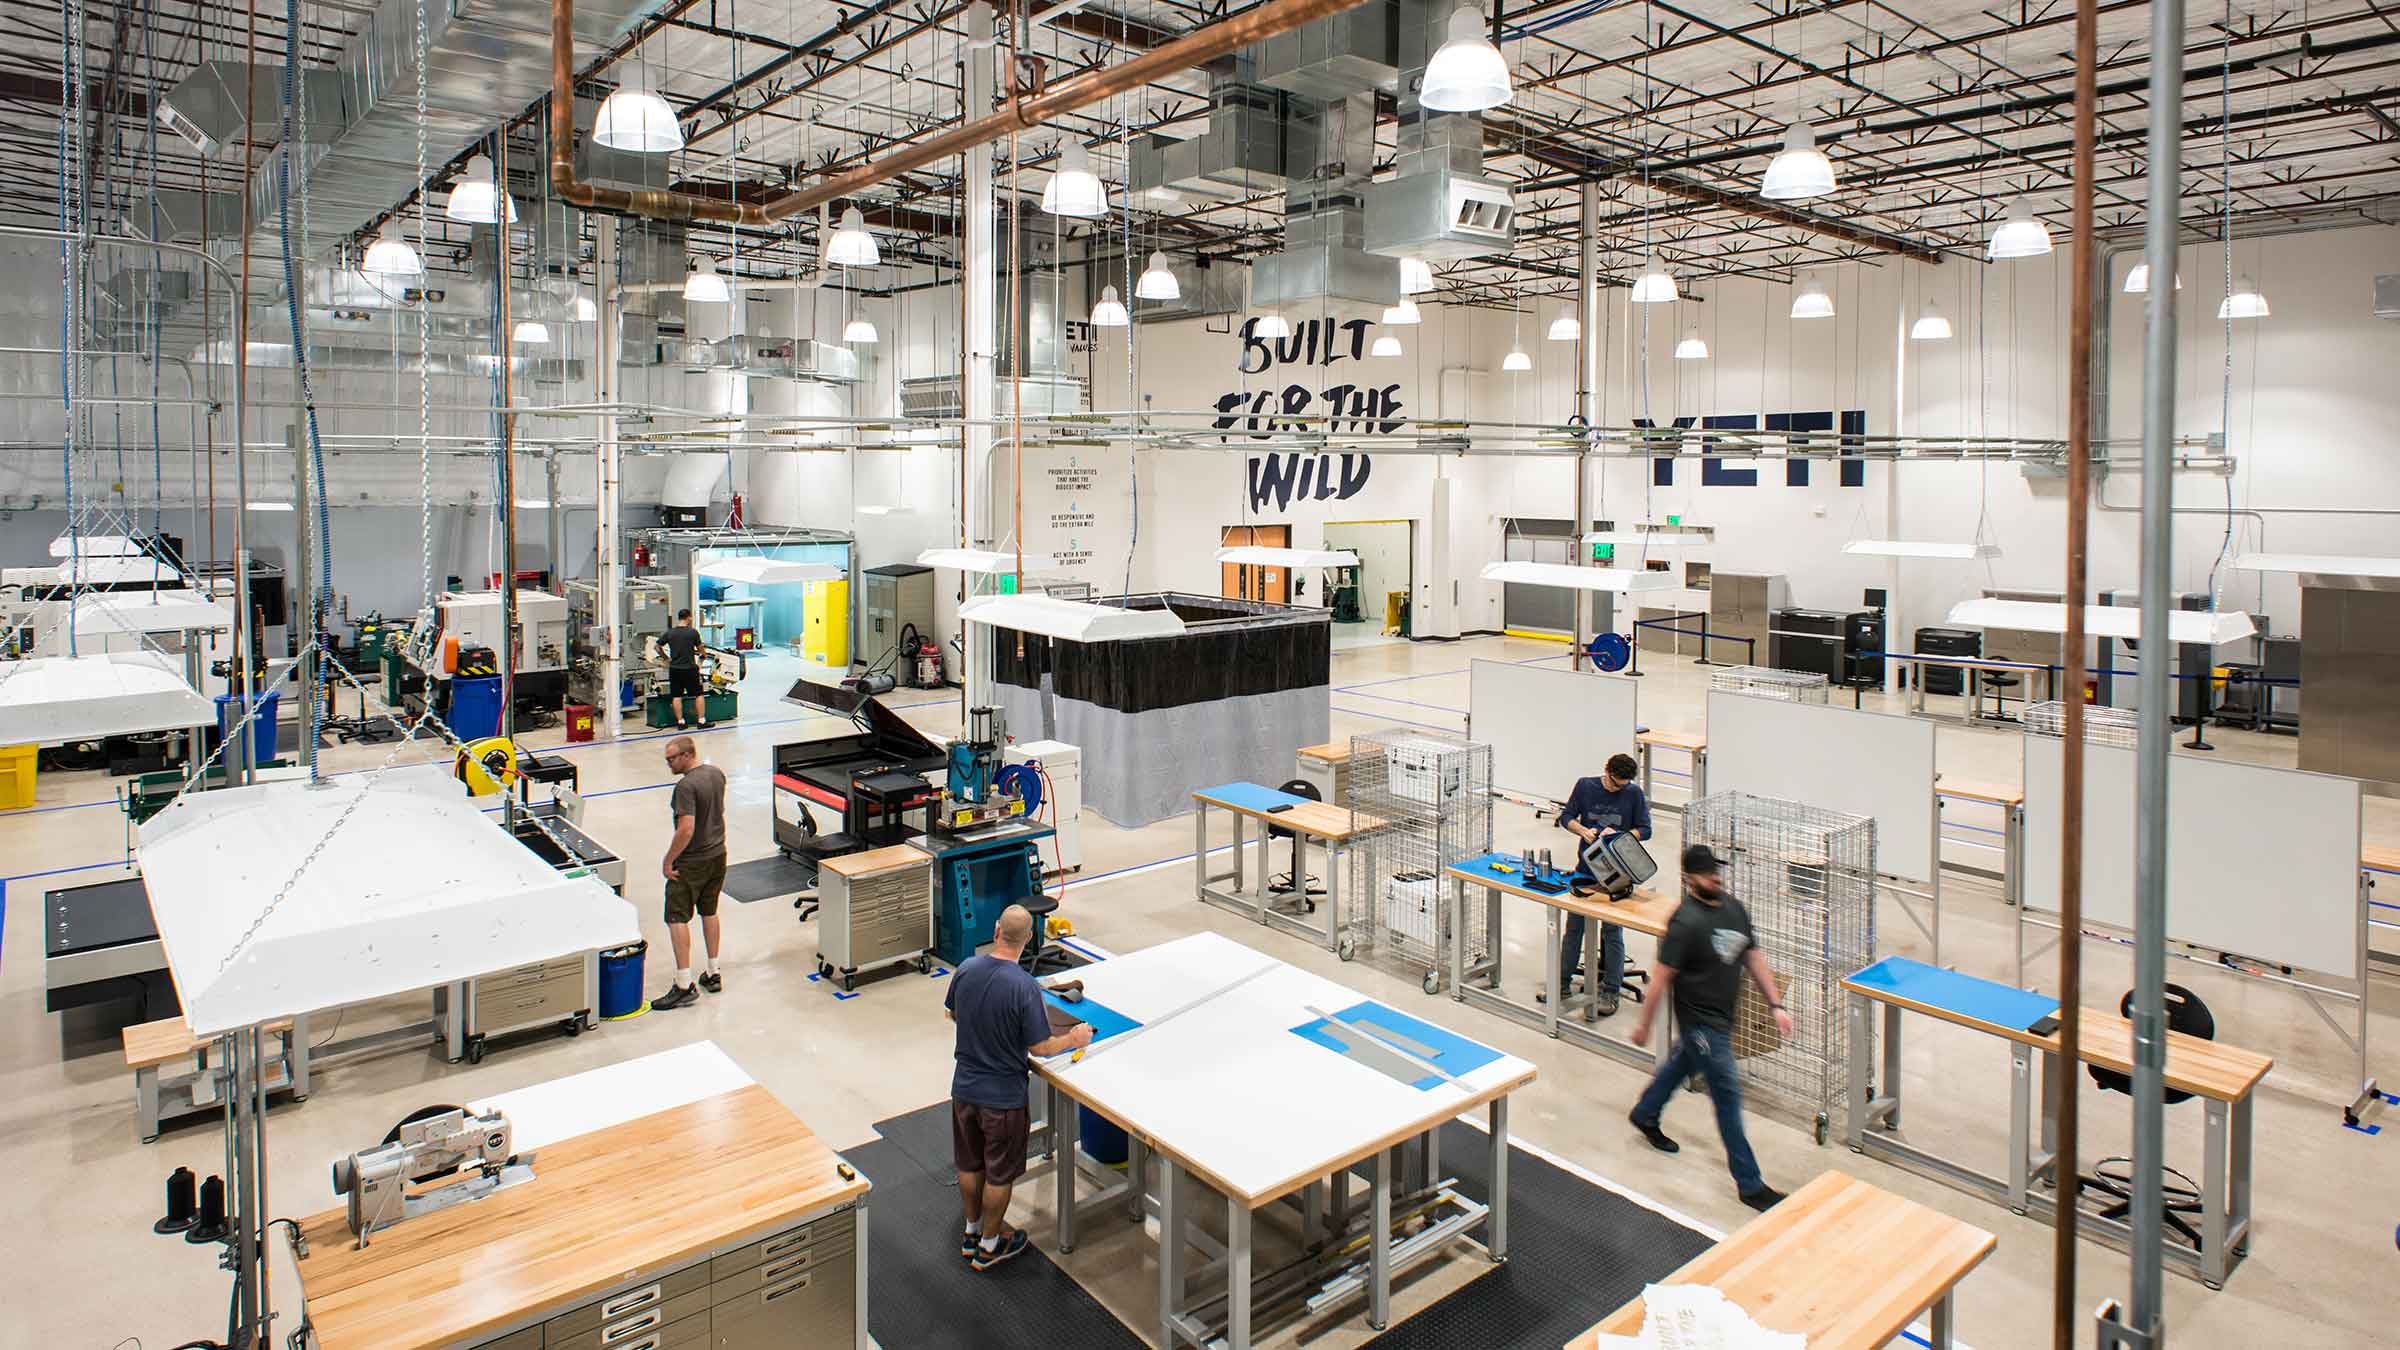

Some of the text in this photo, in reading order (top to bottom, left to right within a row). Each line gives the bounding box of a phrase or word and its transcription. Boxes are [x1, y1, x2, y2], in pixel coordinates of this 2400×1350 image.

[1066, 320, 1098, 342] ETI
[1071, 343, 1099, 353] VALUES
[1238, 316, 1375, 375] BUILT
[1211, 383, 1407, 443] FOR THE
[1070, 456, 1076, 467] 3
[1632, 410, 1865, 486] YETI
[1248, 447, 1371, 515] WILD
[1070, 539, 1077, 550] 5
